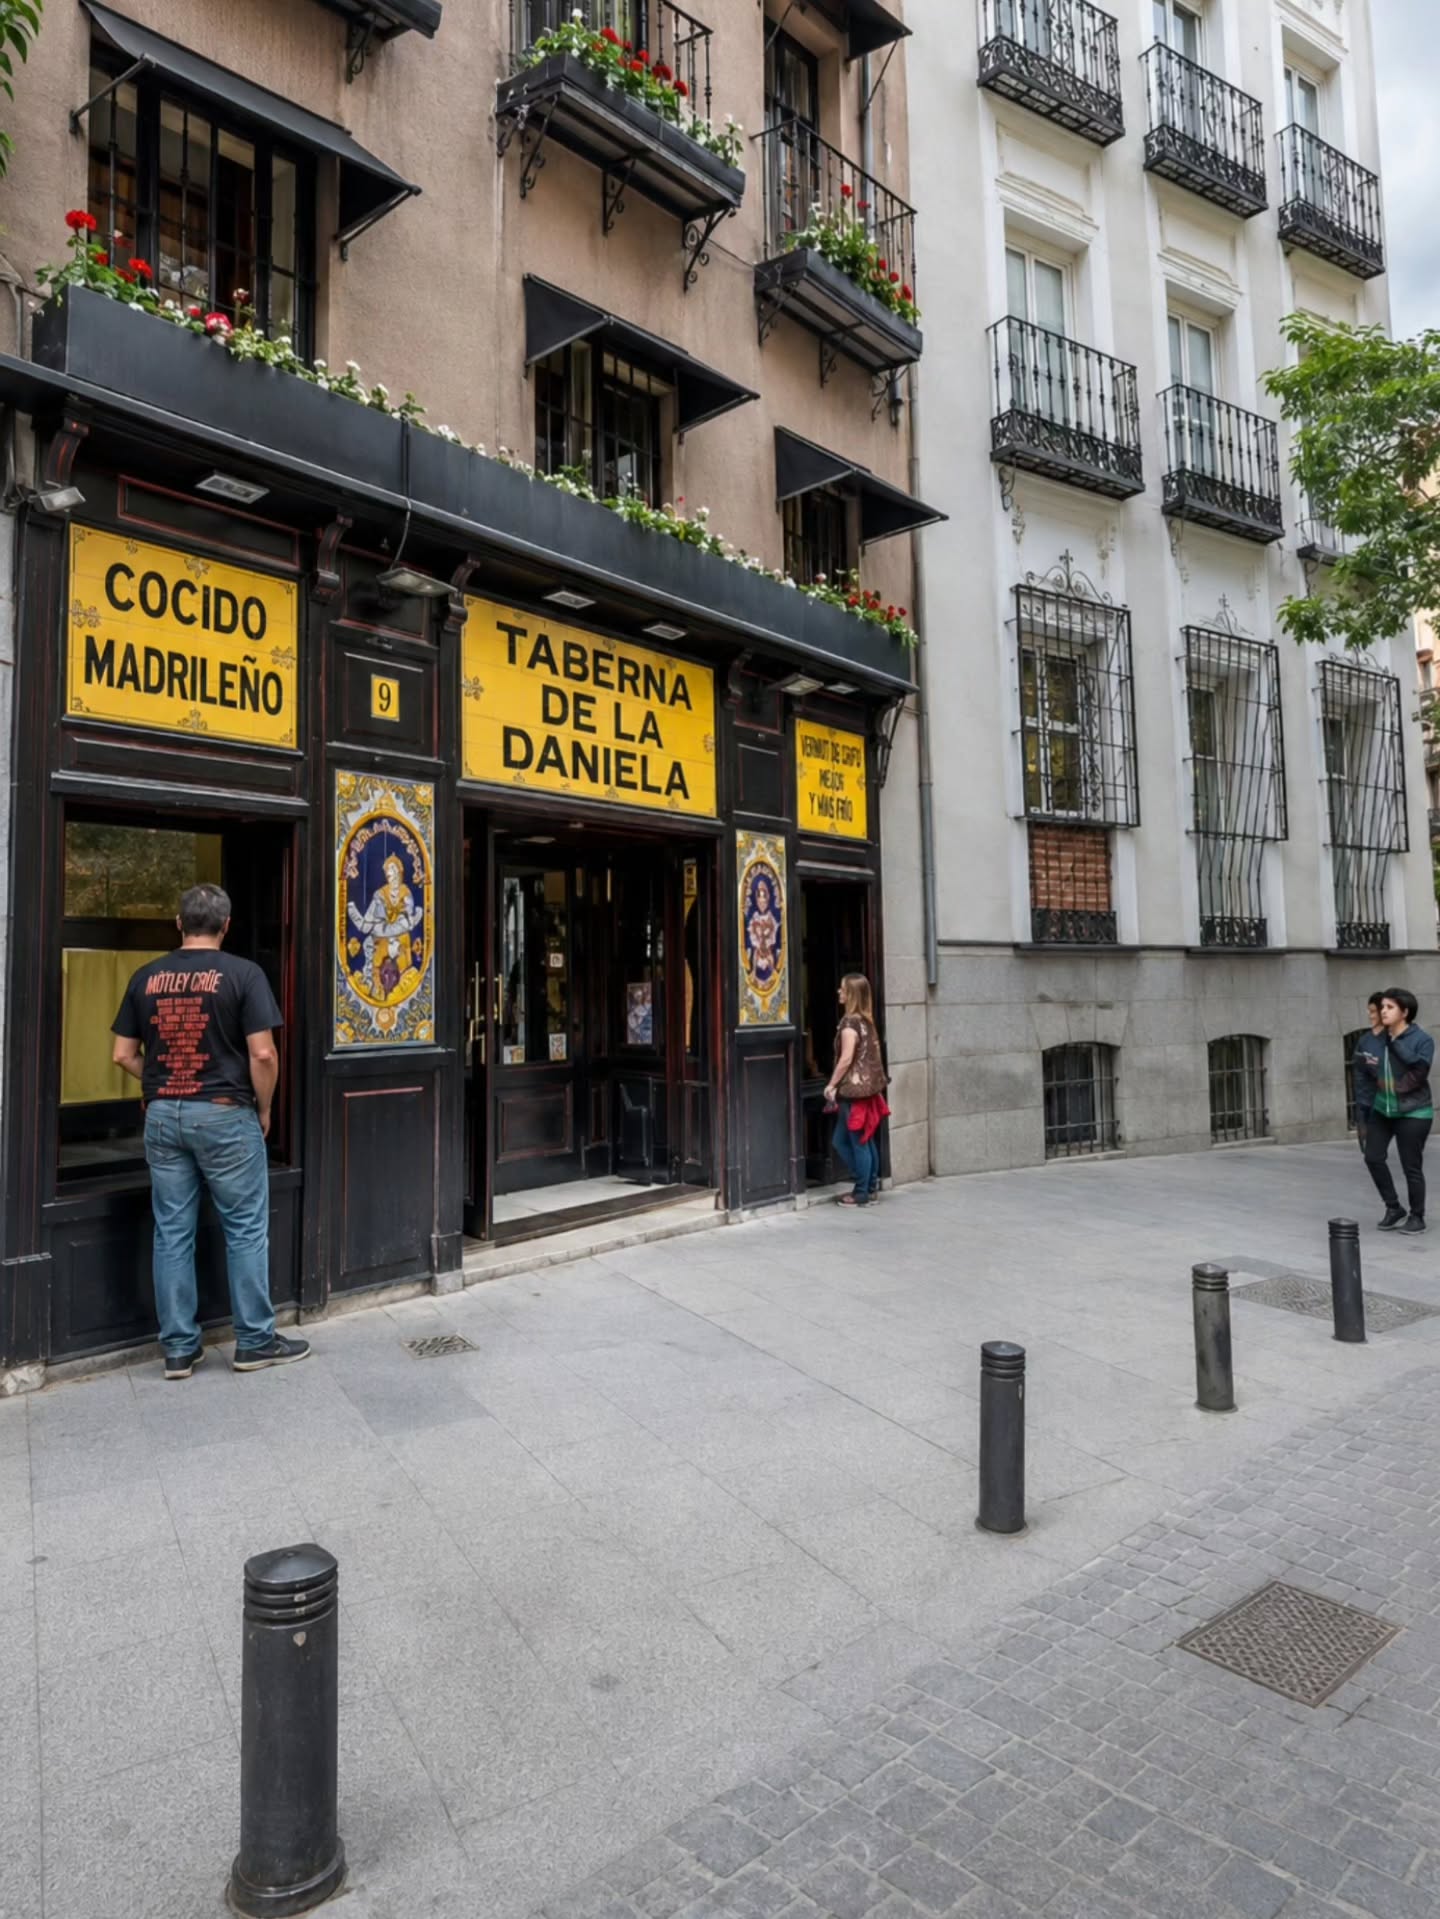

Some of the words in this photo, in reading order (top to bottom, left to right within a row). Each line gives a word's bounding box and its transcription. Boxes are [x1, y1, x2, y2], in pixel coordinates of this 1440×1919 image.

[105, 562, 267, 641] COCIDO
[84, 634, 283, 716] MADRILEÑO
[379, 682, 391, 712] 9
[496, 620, 693, 711] TABERNA
[542, 683, 597, 734] DE
[614, 701, 664, 749] LA
[503, 725, 690, 800] DANIELA
